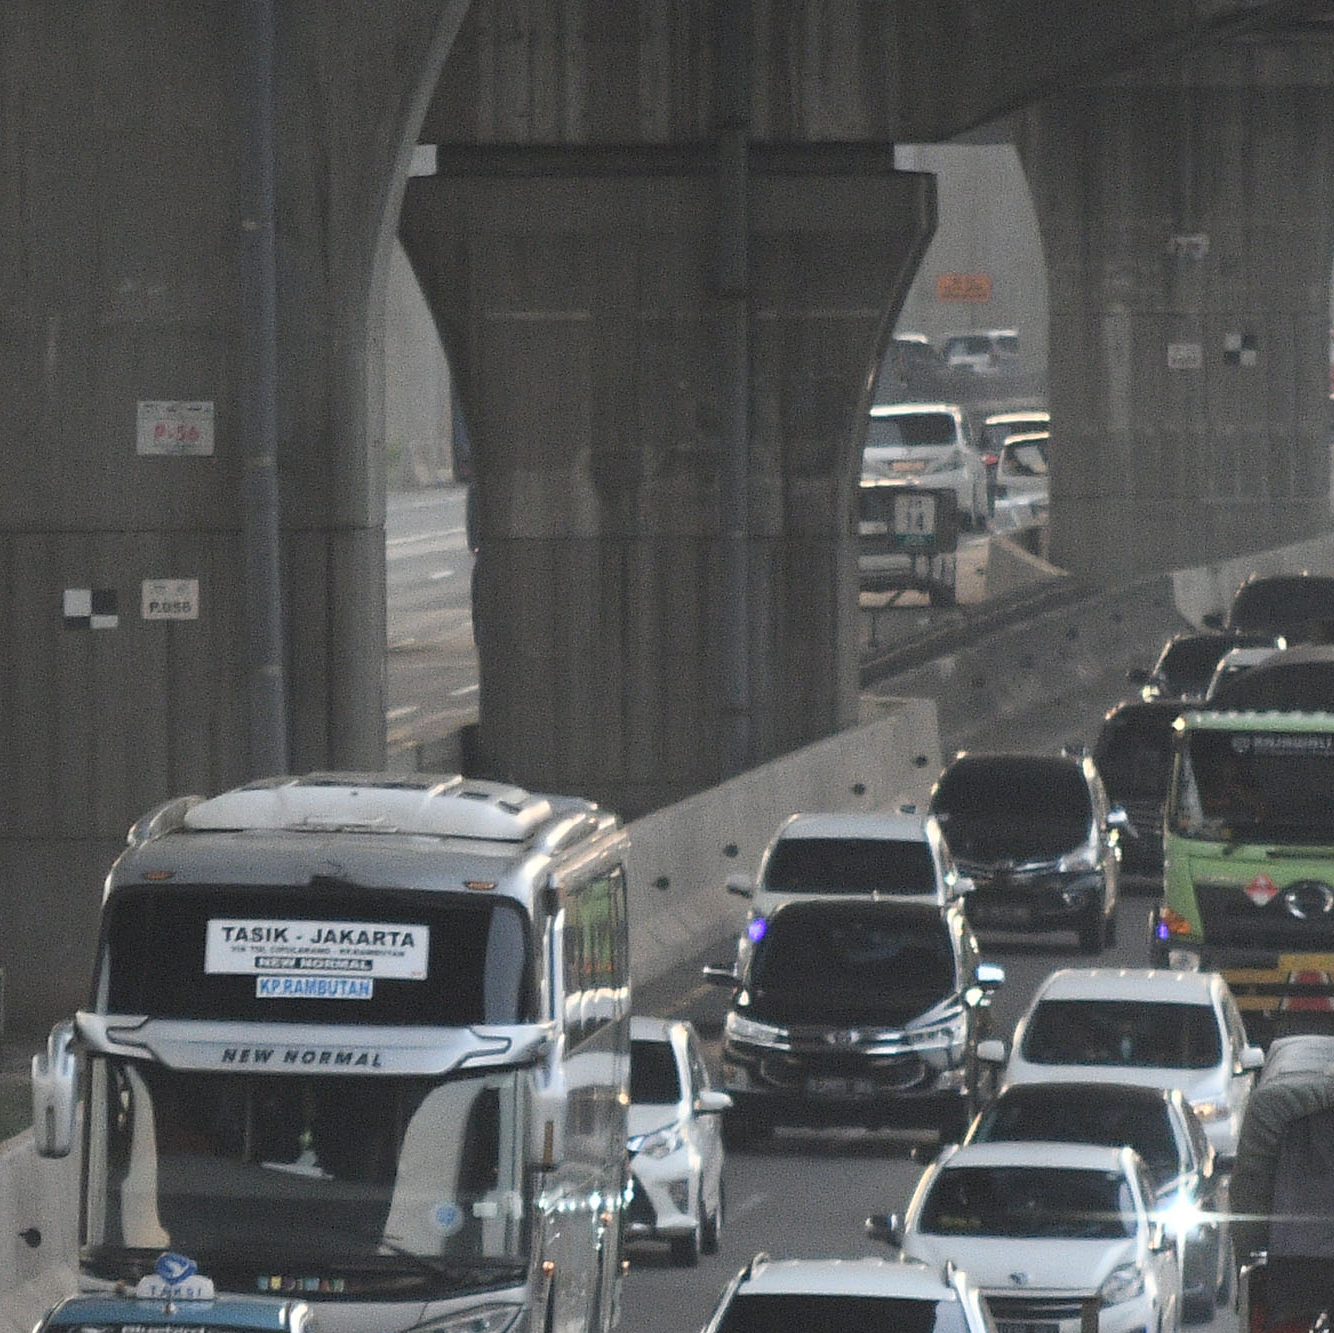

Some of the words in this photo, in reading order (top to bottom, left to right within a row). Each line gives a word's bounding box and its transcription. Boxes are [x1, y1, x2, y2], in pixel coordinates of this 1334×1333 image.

[221, 926, 289, 944] TASIK
[310, 928, 415, 948] JAKARTA
[222, 1048, 274, 1064] NEW
[283, 1050, 383, 1069] NORMAL
